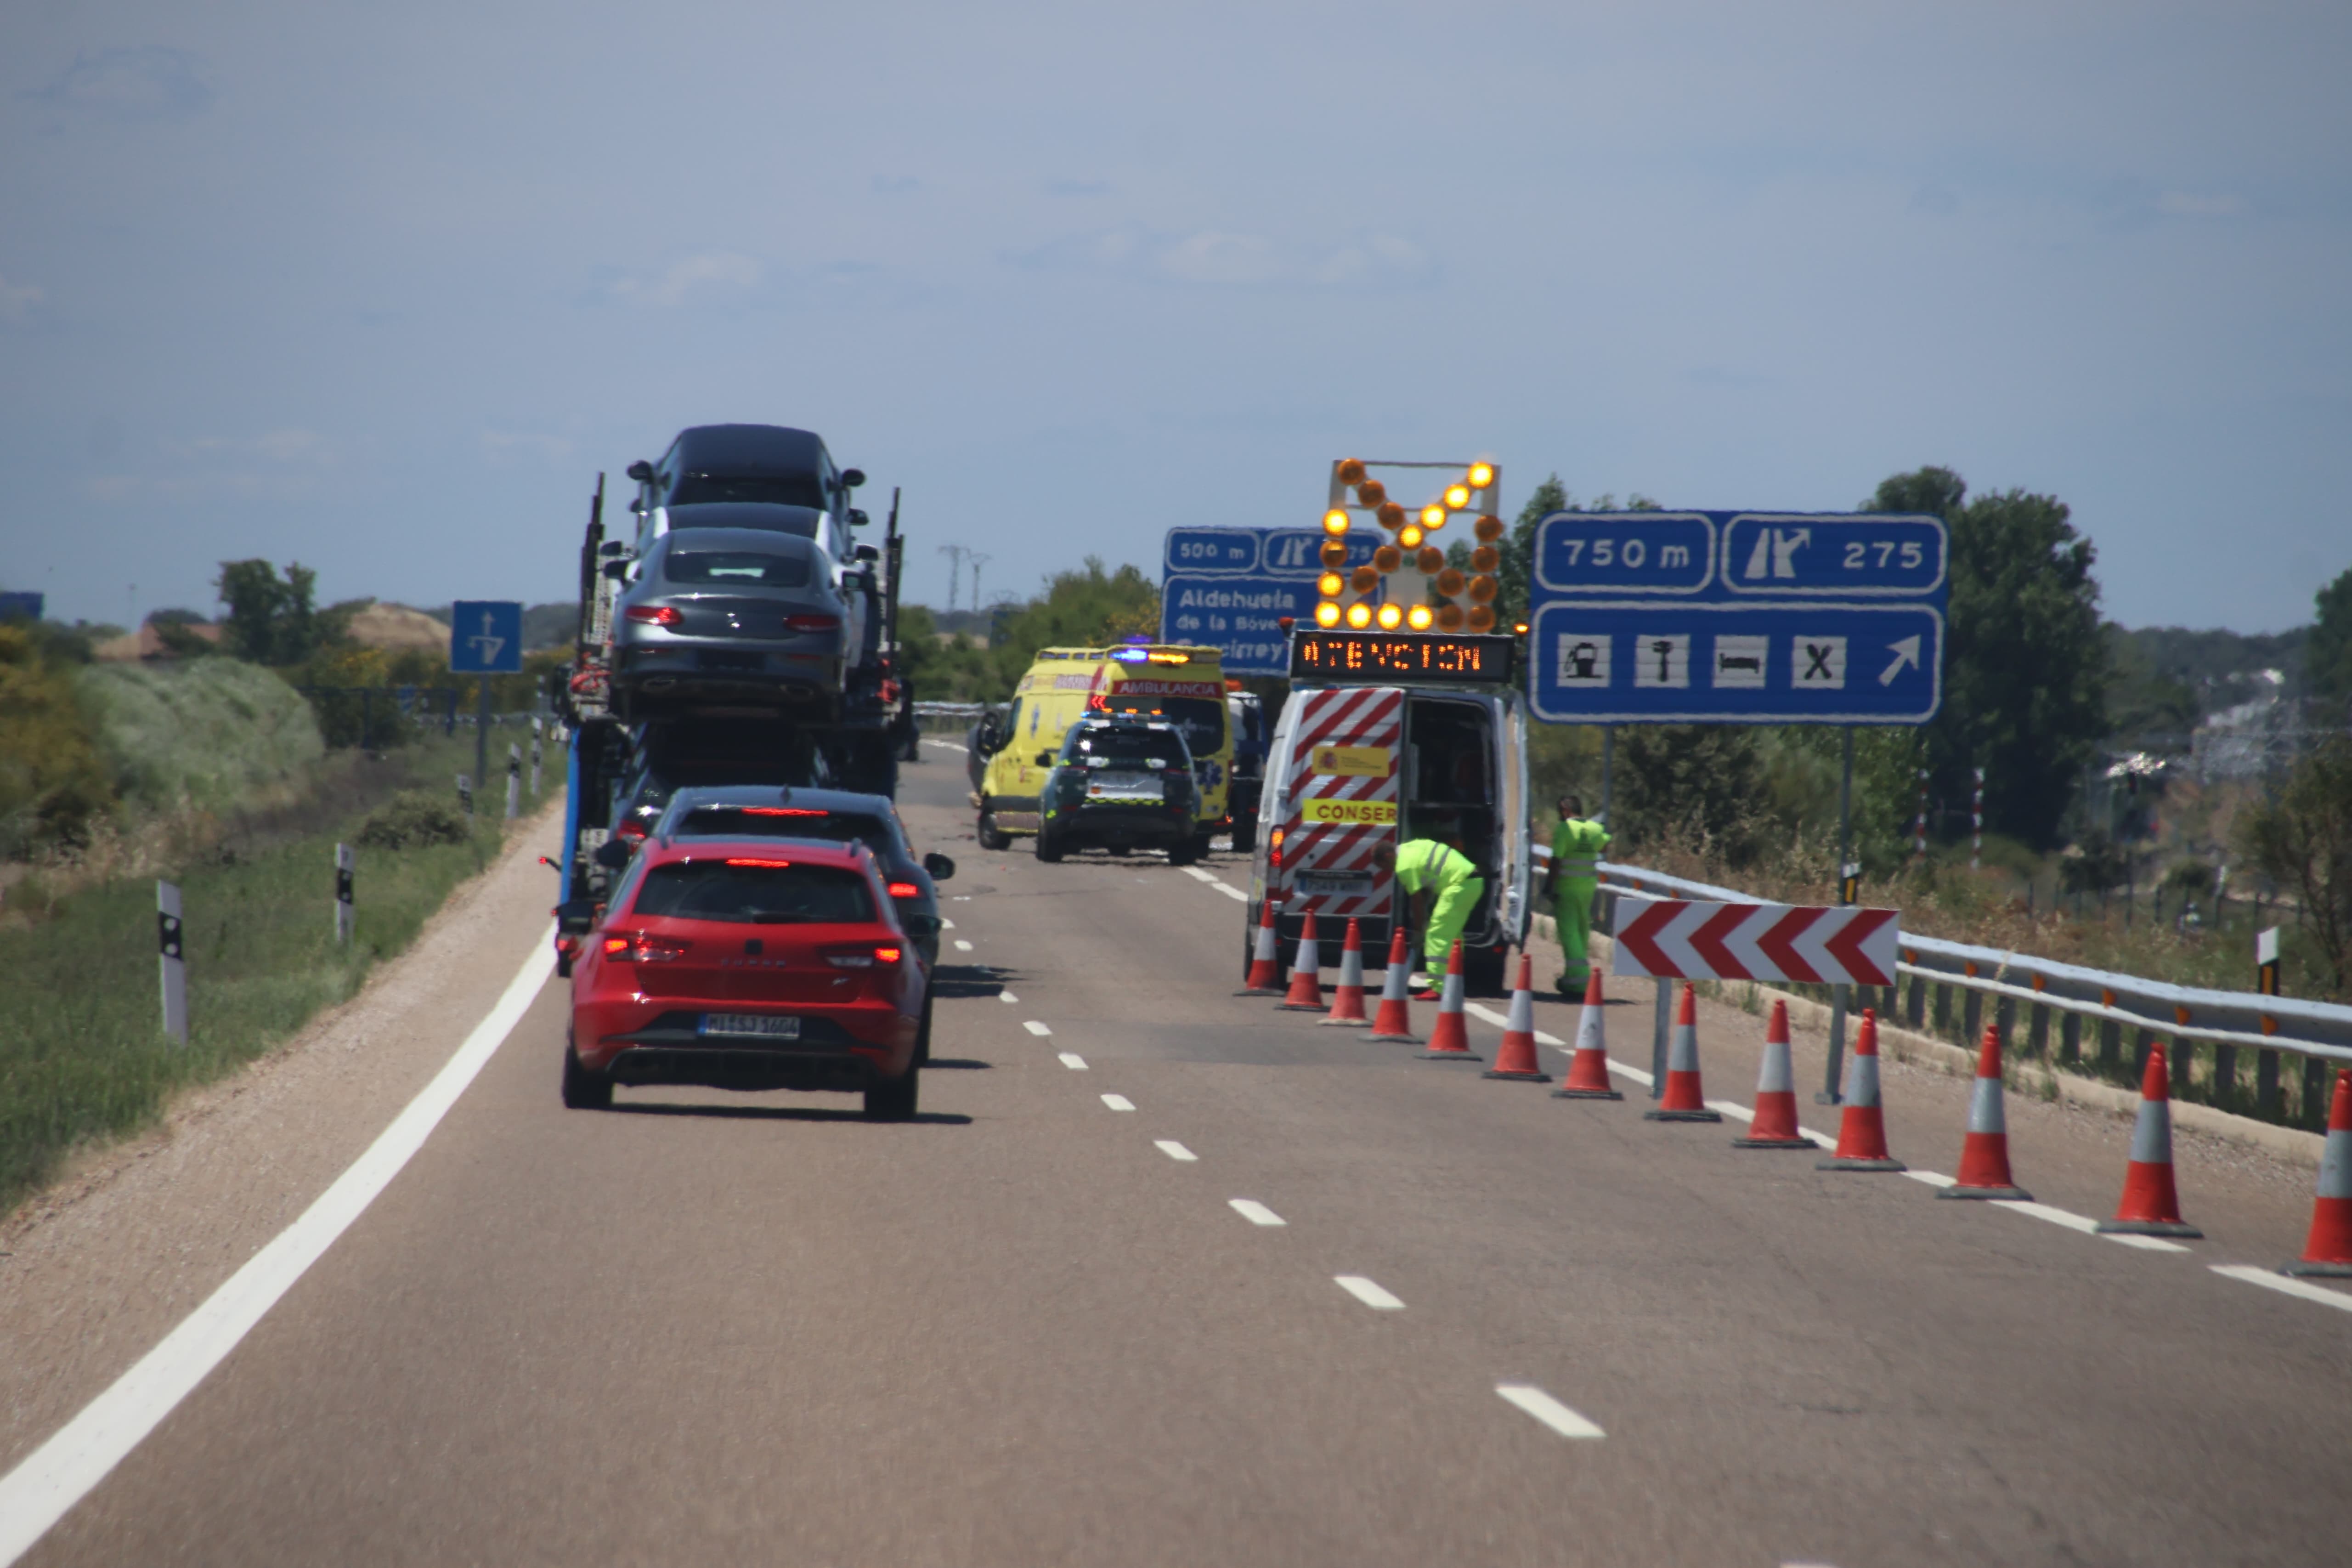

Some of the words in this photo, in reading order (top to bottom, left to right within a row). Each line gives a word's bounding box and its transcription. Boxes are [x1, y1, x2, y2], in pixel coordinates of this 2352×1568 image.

[1180, 543, 1217, 558] 500
[1229, 547, 1245, 560] m
[1563, 539, 1646, 568] 750
[1659, 544, 1690, 569] m
[1843, 543, 1923, 569] 275
[1179, 589, 1295, 609] Aldehuela
[1176, 614, 1200, 630] de
[1209, 614, 1227, 631] la
[1235, 615, 1279, 631] Bóve
[1119, 681, 1216, 695] AMBULANCIA
[1317, 805, 1396, 821] CONSER
